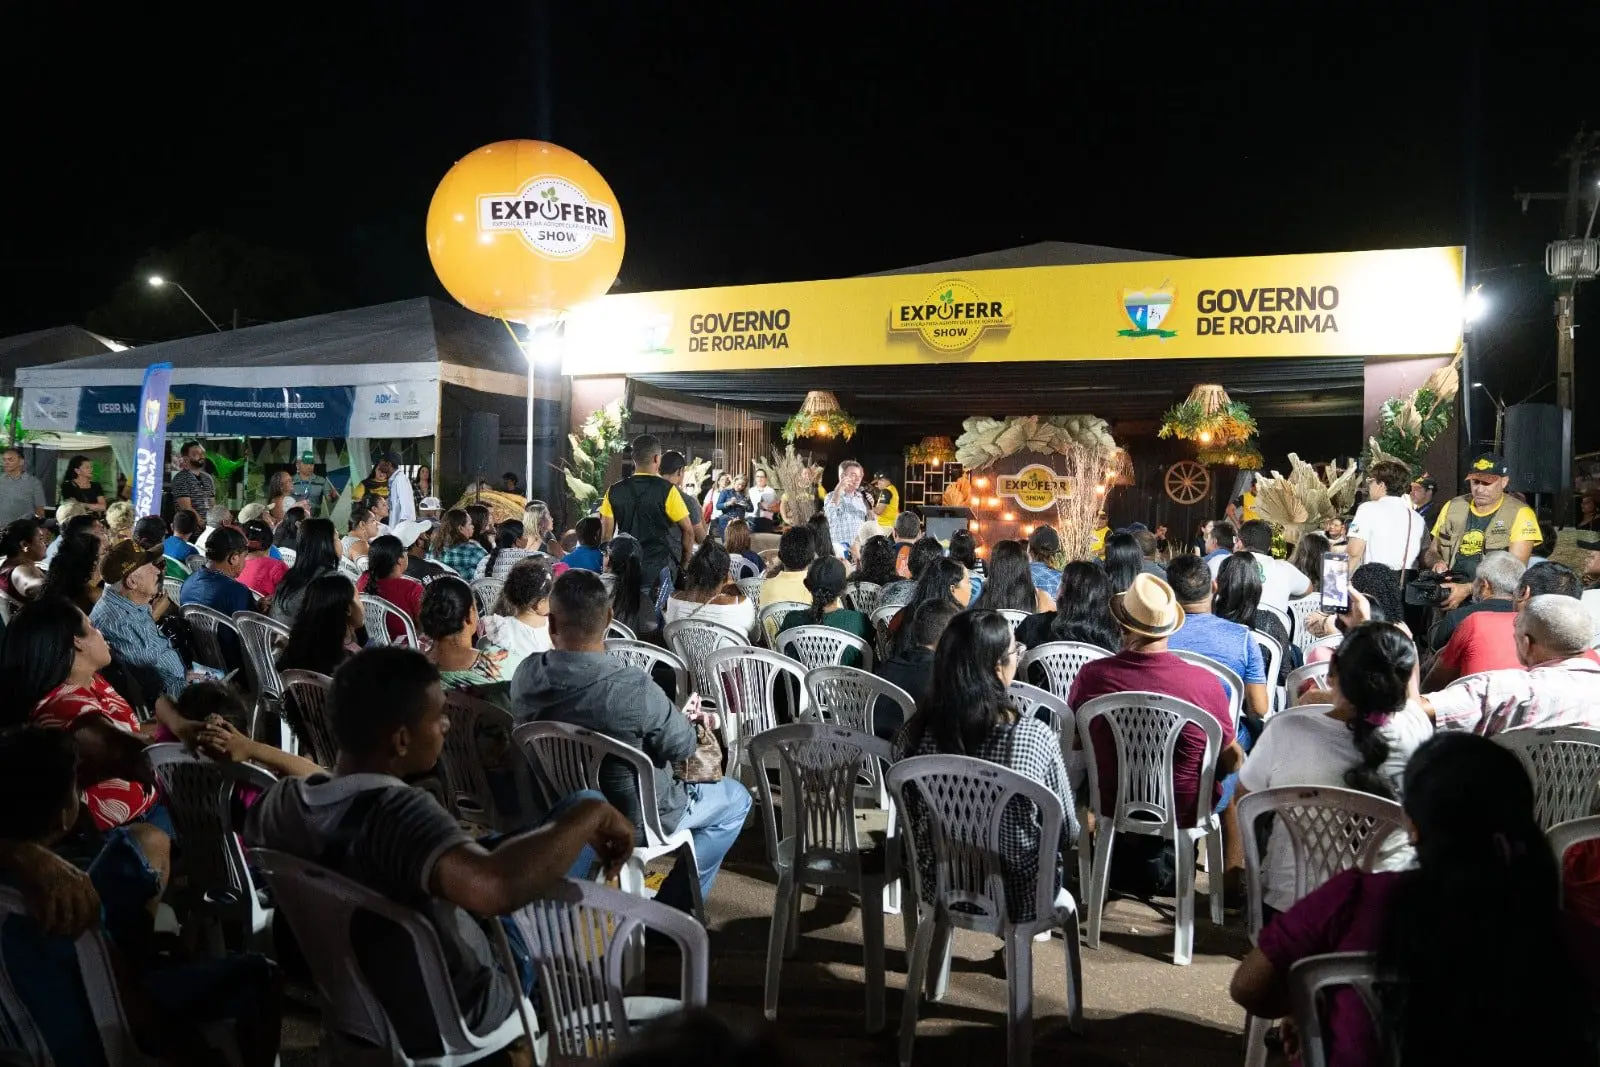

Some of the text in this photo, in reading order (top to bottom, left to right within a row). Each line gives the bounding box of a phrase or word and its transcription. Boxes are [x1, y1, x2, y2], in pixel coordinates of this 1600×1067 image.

[491, 200, 608, 228] EXPOFERR
[538, 230, 577, 242] SHOW
[1197, 285, 1339, 314] GOVERNO
[901, 302, 1003, 321] EXPOFERR
[690, 309, 790, 334] GOVERNO
[1197, 314, 1339, 336] DE RORAIMA
[933, 328, 968, 337] SHOW
[689, 333, 789, 352] DE RORAIMA
[98, 403, 121, 414] UERR
[123, 403, 136, 413] NA
